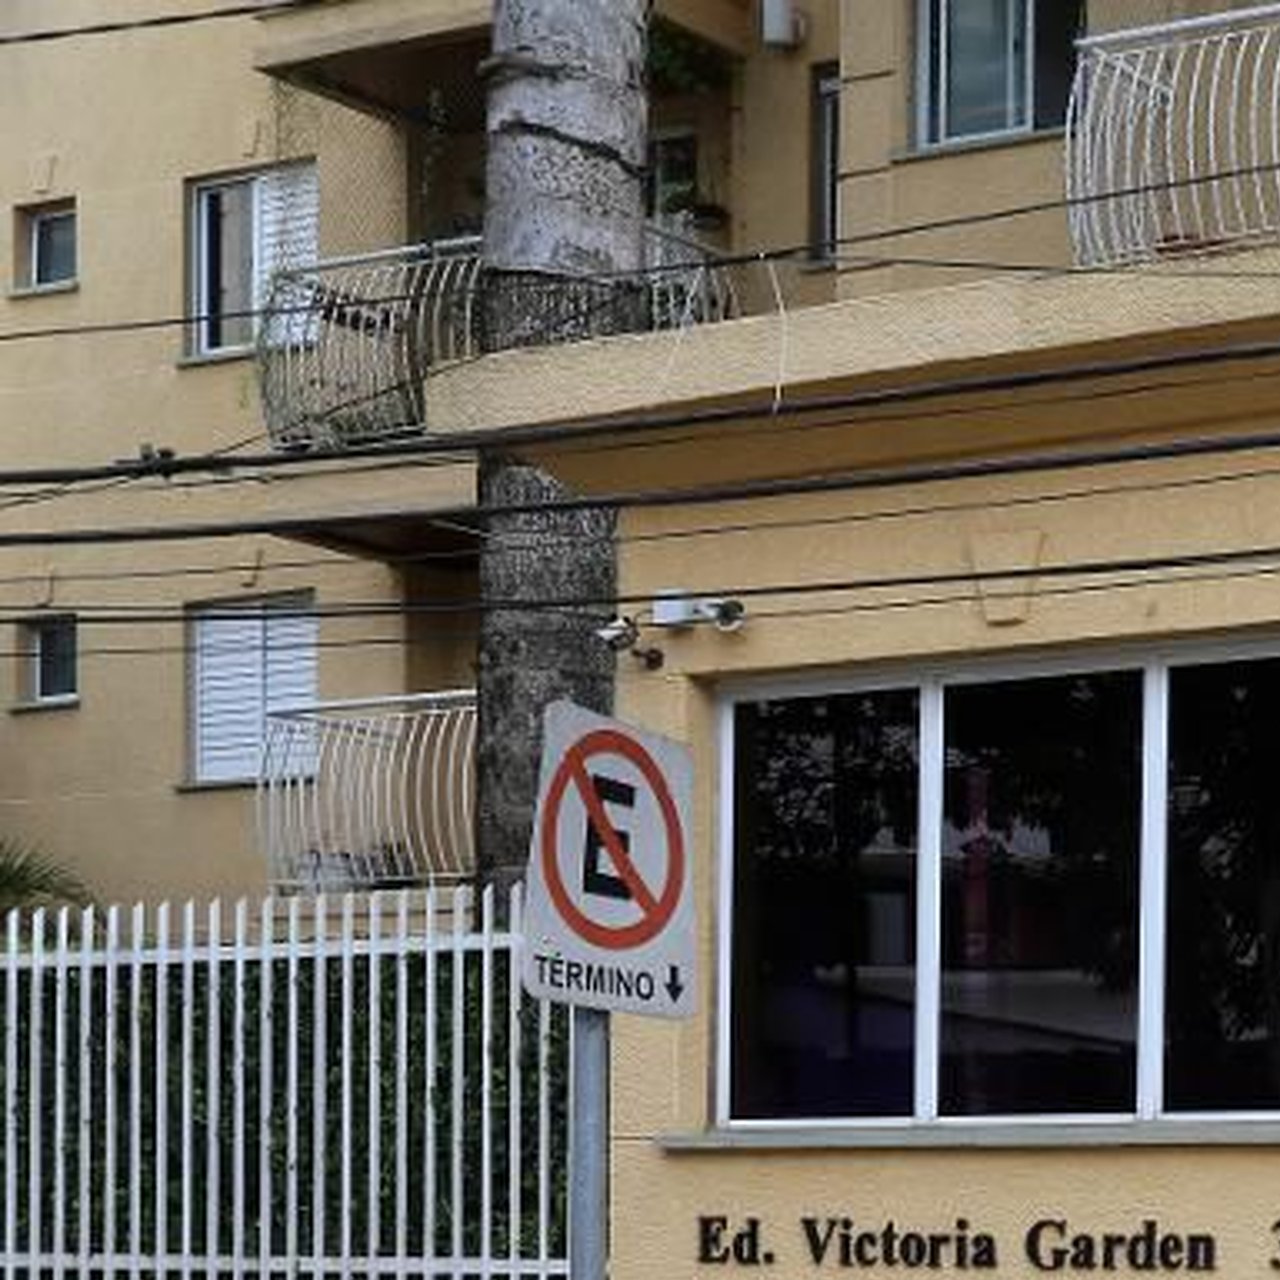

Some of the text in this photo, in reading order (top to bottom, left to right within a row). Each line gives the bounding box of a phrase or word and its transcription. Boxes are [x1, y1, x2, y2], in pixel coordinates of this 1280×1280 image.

[533, 951, 654, 1001] TÉRMINO
[698, 1216, 775, 1266] Ed.
[802, 1217, 998, 1270] Victoria
[1025, 1219, 1216, 1272] Garden
